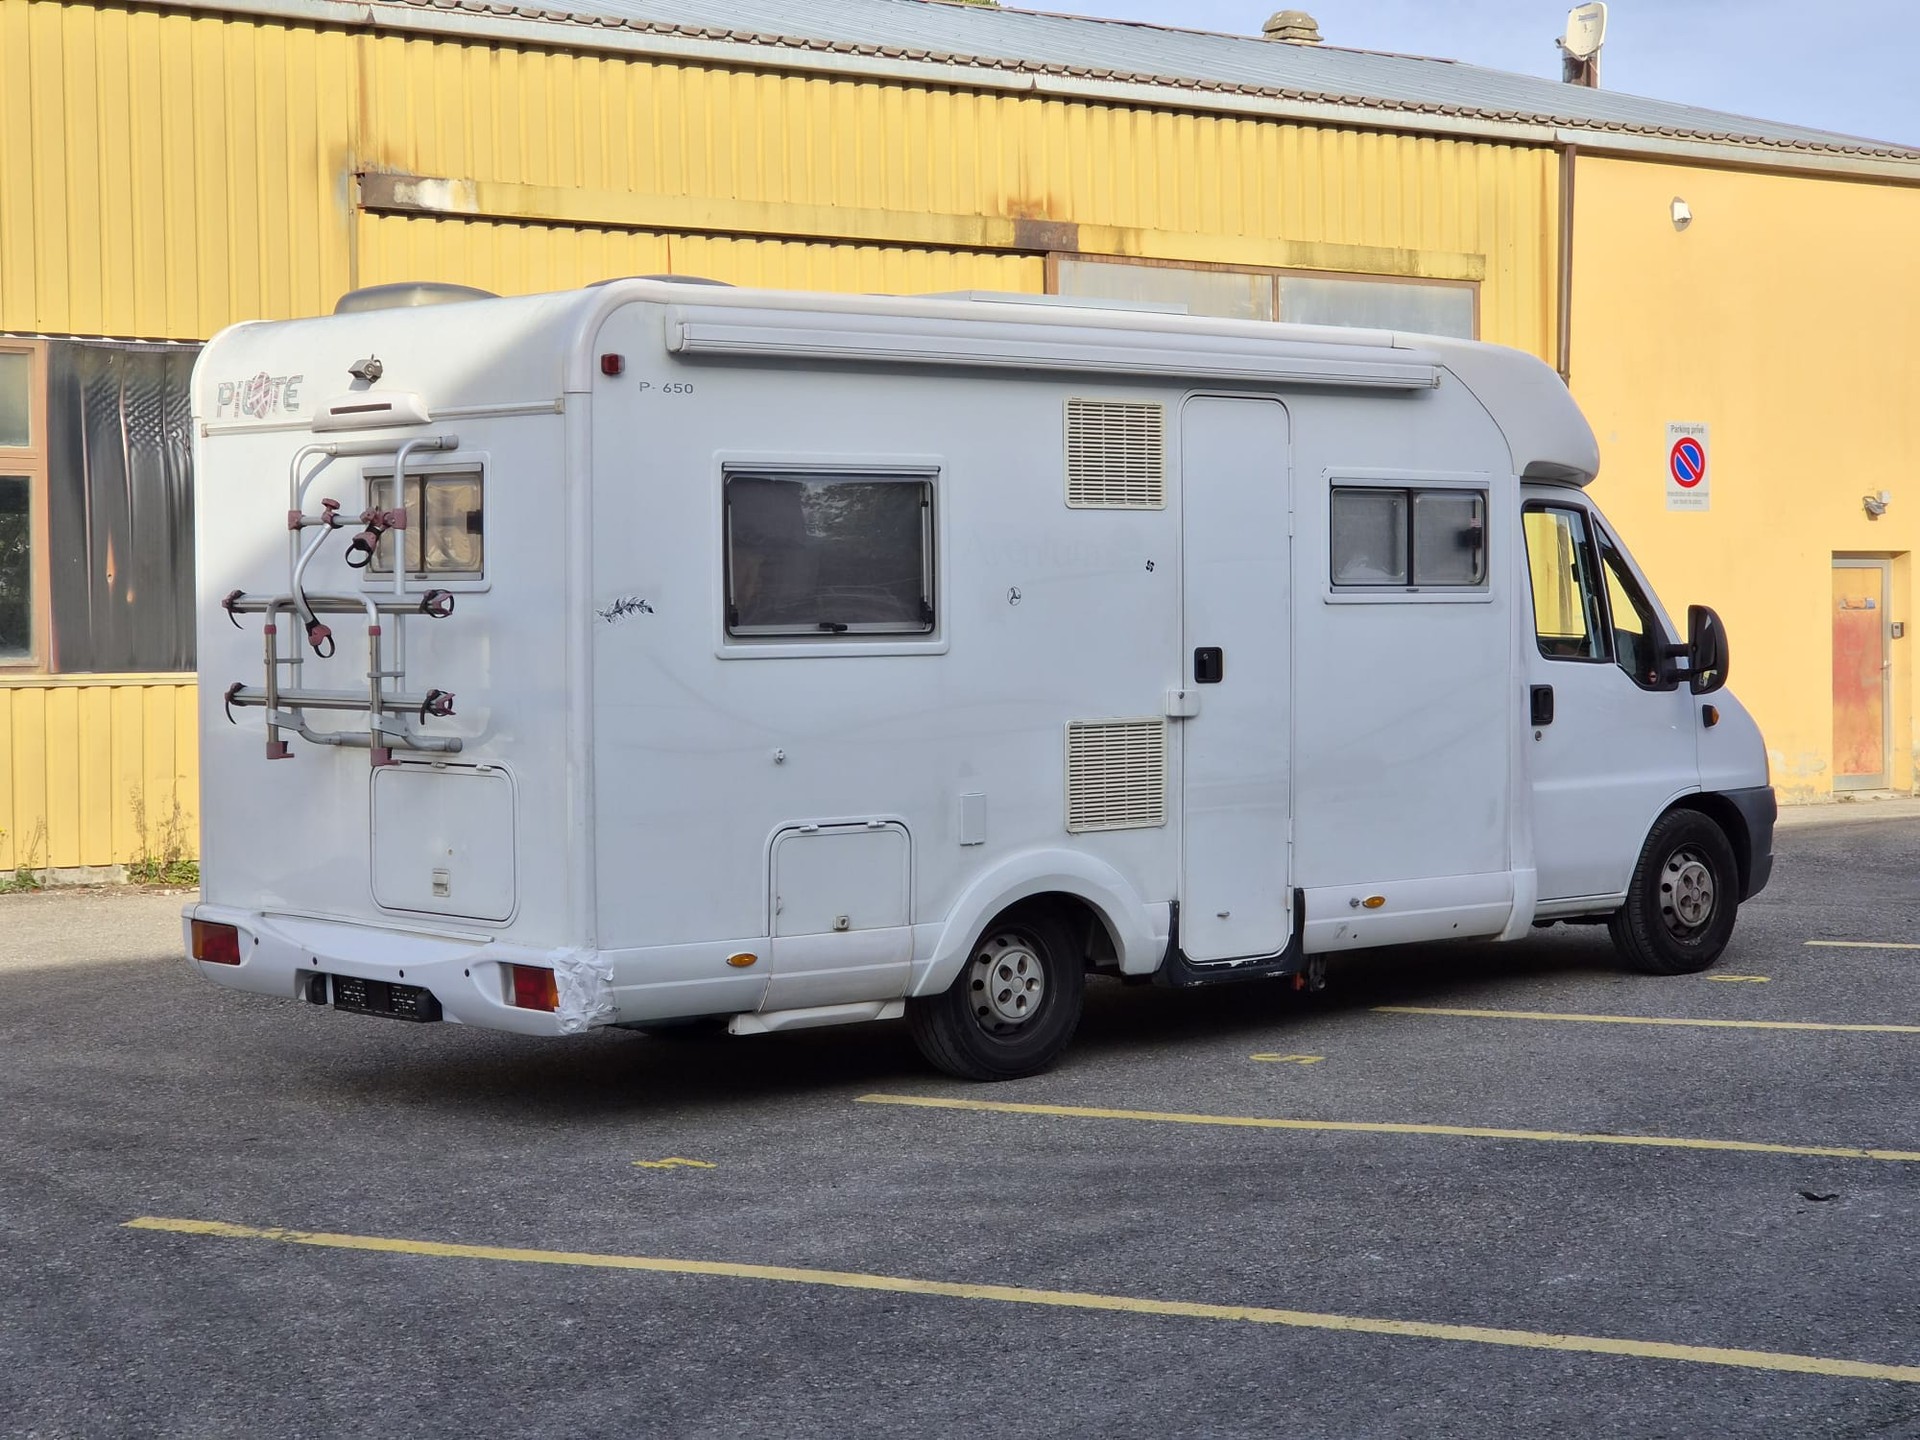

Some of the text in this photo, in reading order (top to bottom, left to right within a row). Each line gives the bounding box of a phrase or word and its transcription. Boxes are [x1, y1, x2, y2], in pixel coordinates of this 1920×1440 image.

[662, 382, 694, 394] 650
[1670, 423, 1704, 435] Parking privé
